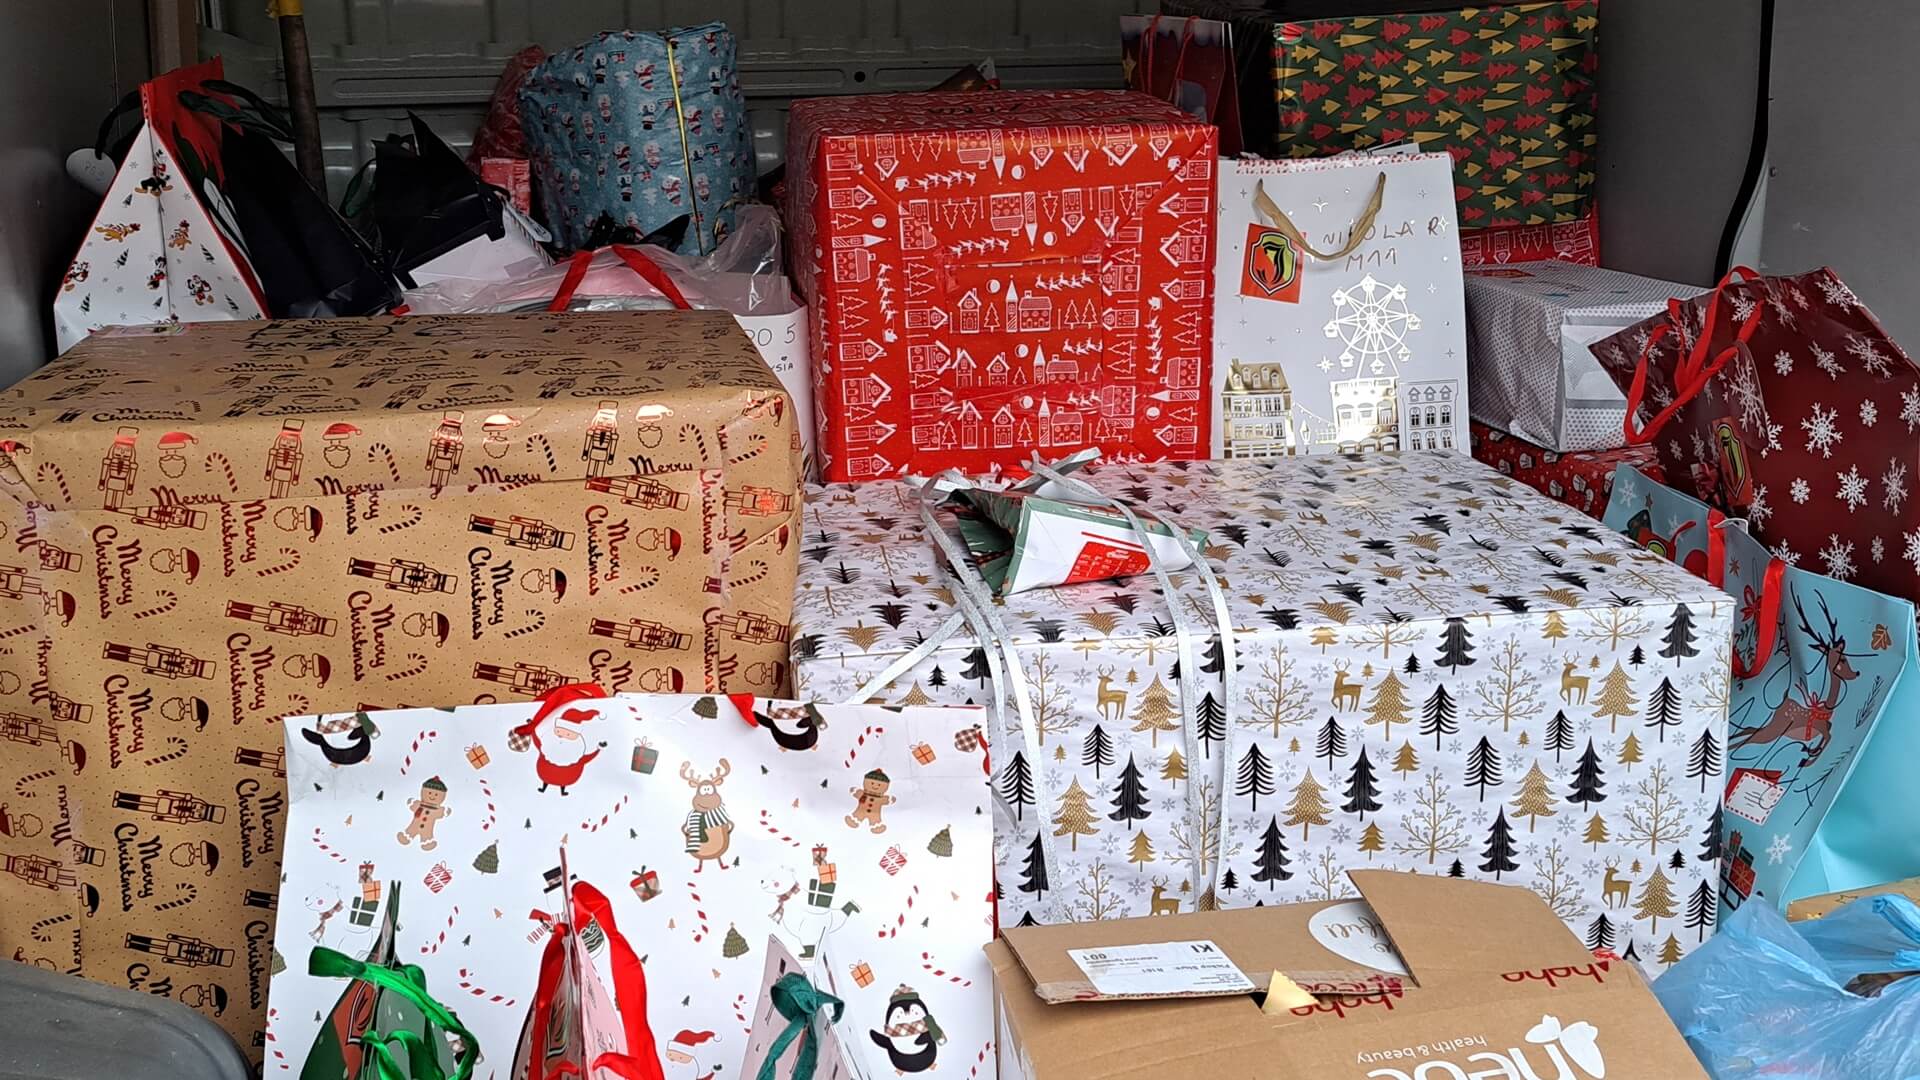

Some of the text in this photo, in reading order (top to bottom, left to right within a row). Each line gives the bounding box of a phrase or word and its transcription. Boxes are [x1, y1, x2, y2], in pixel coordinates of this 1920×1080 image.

[1323, 222, 1414, 244] NIOLA
[784, 322, 796, 344] 5
[772, 362, 794, 372] SIA
[92, 413, 196, 422] Christmas
[116, 407, 183, 416] Merry
[240, 500, 267, 563] Merry
[700, 468, 721, 555] Christmas
[93, 524, 118, 620] Christmas
[116, 539, 142, 605] Merry
[585, 505, 608, 596] Christmas
[605, 518, 630, 582] Merry
[468, 546, 492, 640] Christmas
[491, 560, 514, 626] Merry
[348, 590, 372, 682] Christmas
[370, 603, 395, 669] Merry
[226, 633, 251, 725] Christmas
[249, 646, 275, 711] Merry
[103, 674, 129, 769] Christmas
[128, 688, 153, 755] Merry
[236, 778, 260, 868] Christmas
[259, 791, 284, 854] Merry
[114, 822, 138, 913] Christmas
[137, 835, 162, 899] Merry
[244, 921, 268, 1009] Christmas
[1356, 1034, 1487, 1065] health & beauty
